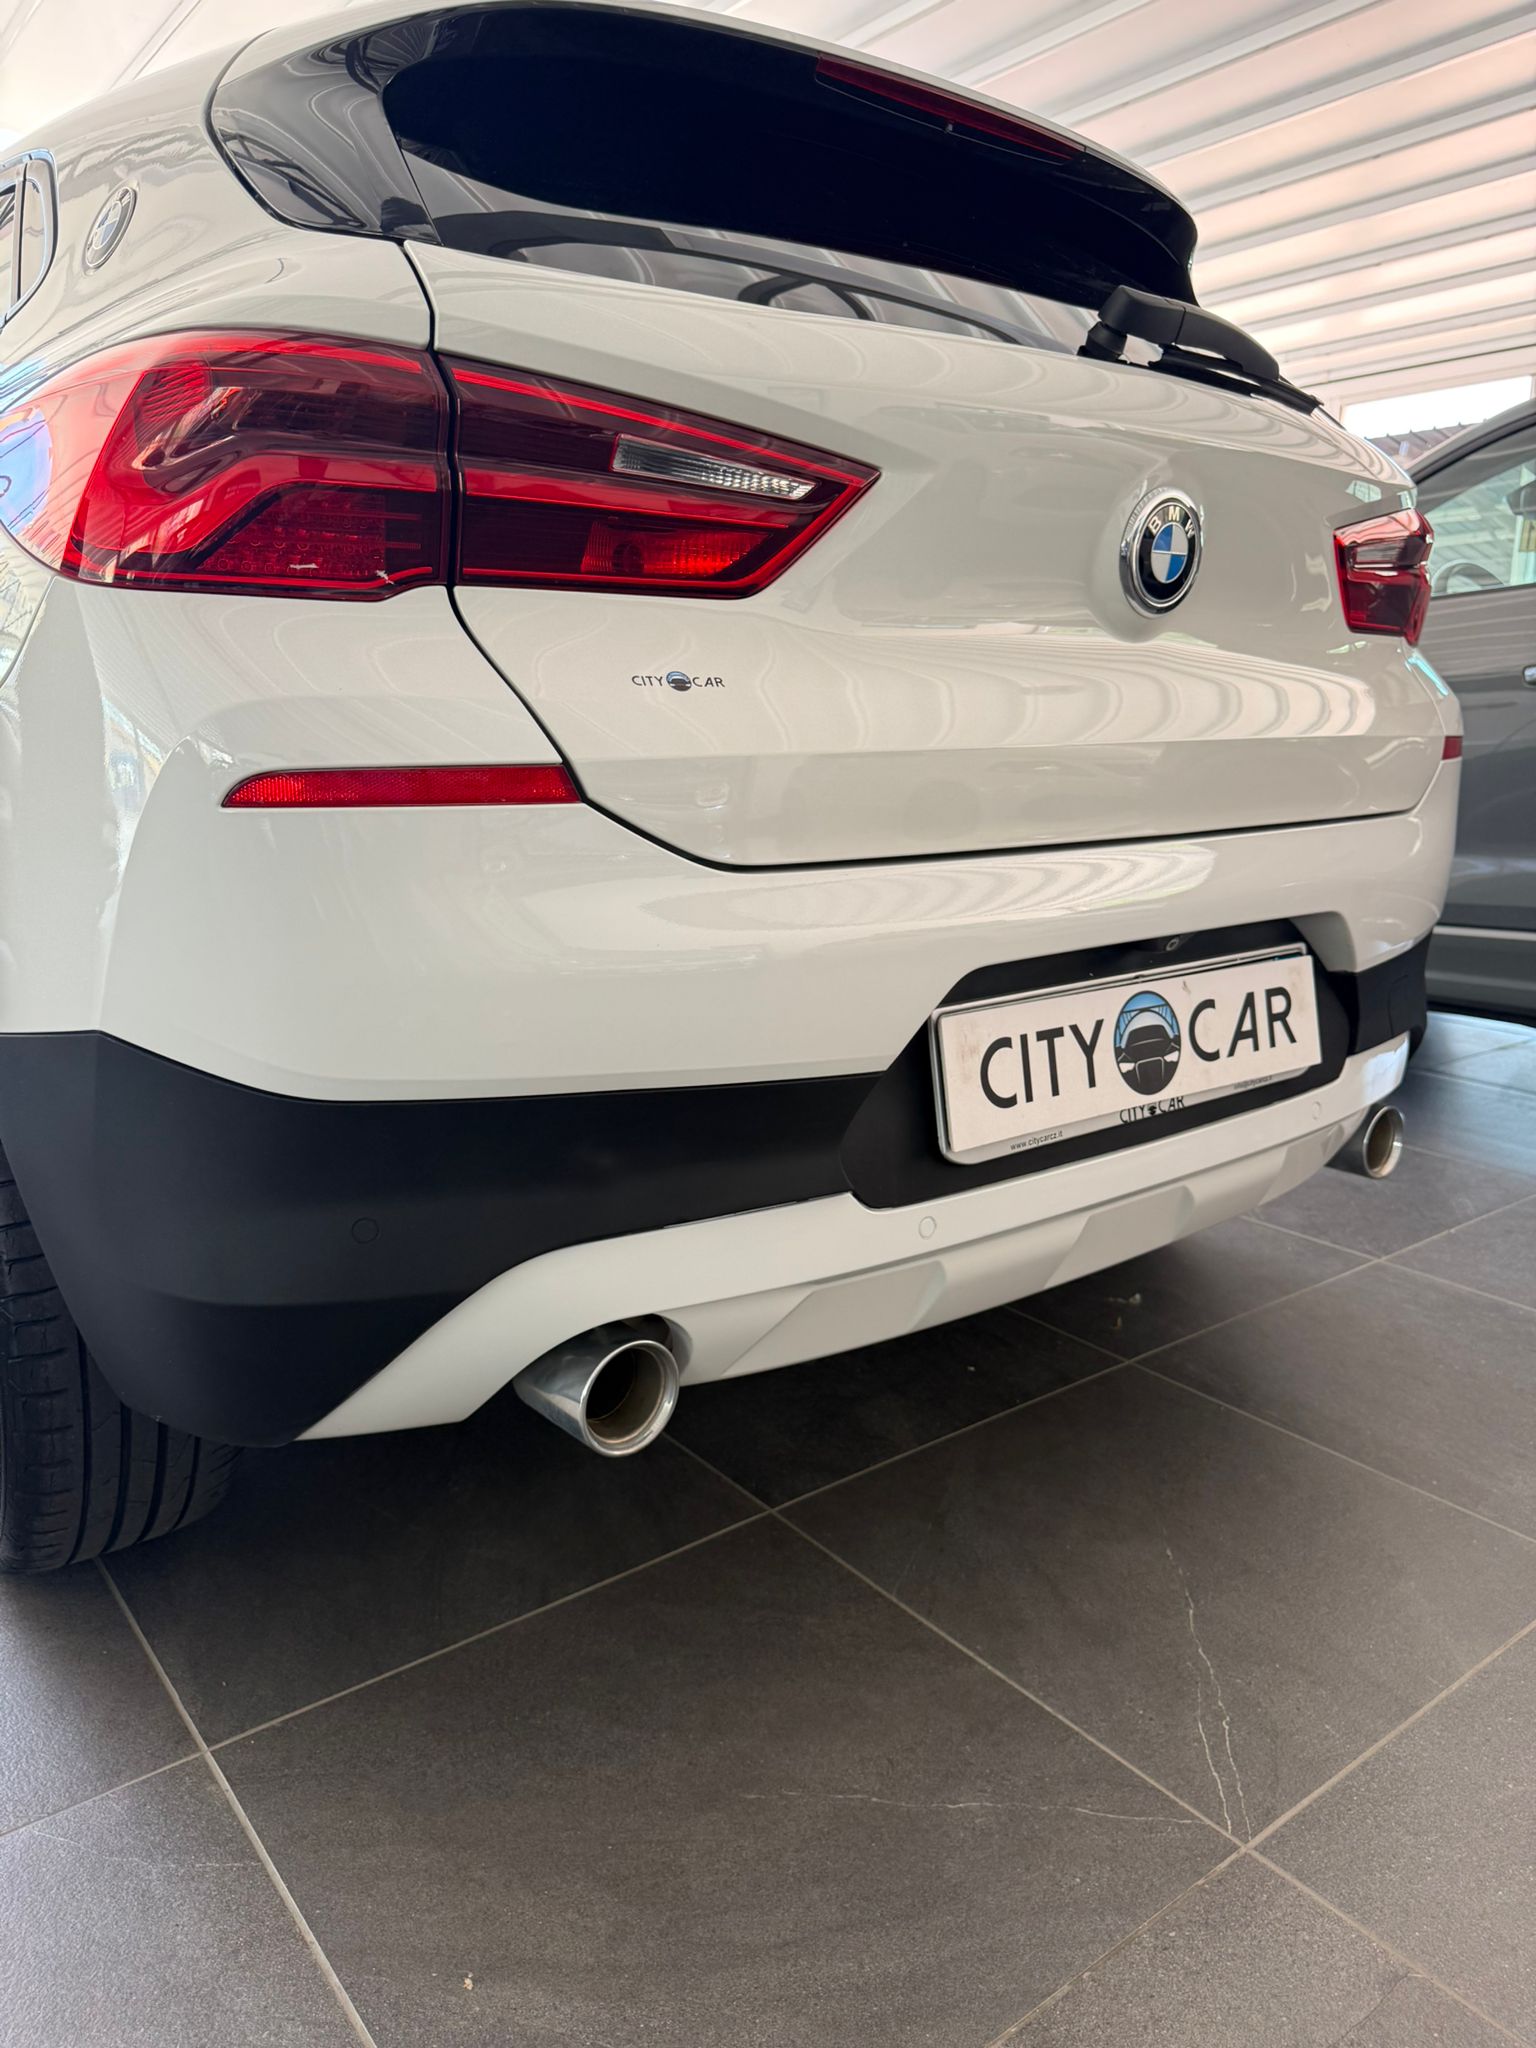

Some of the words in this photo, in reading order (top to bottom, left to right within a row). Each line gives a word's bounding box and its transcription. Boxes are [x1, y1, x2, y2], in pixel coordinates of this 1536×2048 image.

[1147, 505, 1195, 539] BMW
[631, 675, 663, 687] CITY
[692, 676, 725, 688] CAR
[980, 1018, 1105, 1109] CITY
[1188, 986, 1297, 1062] CAR
[1119, 1104, 1145, 1124] CITY
[1158, 1095, 1185, 1113] CAR
